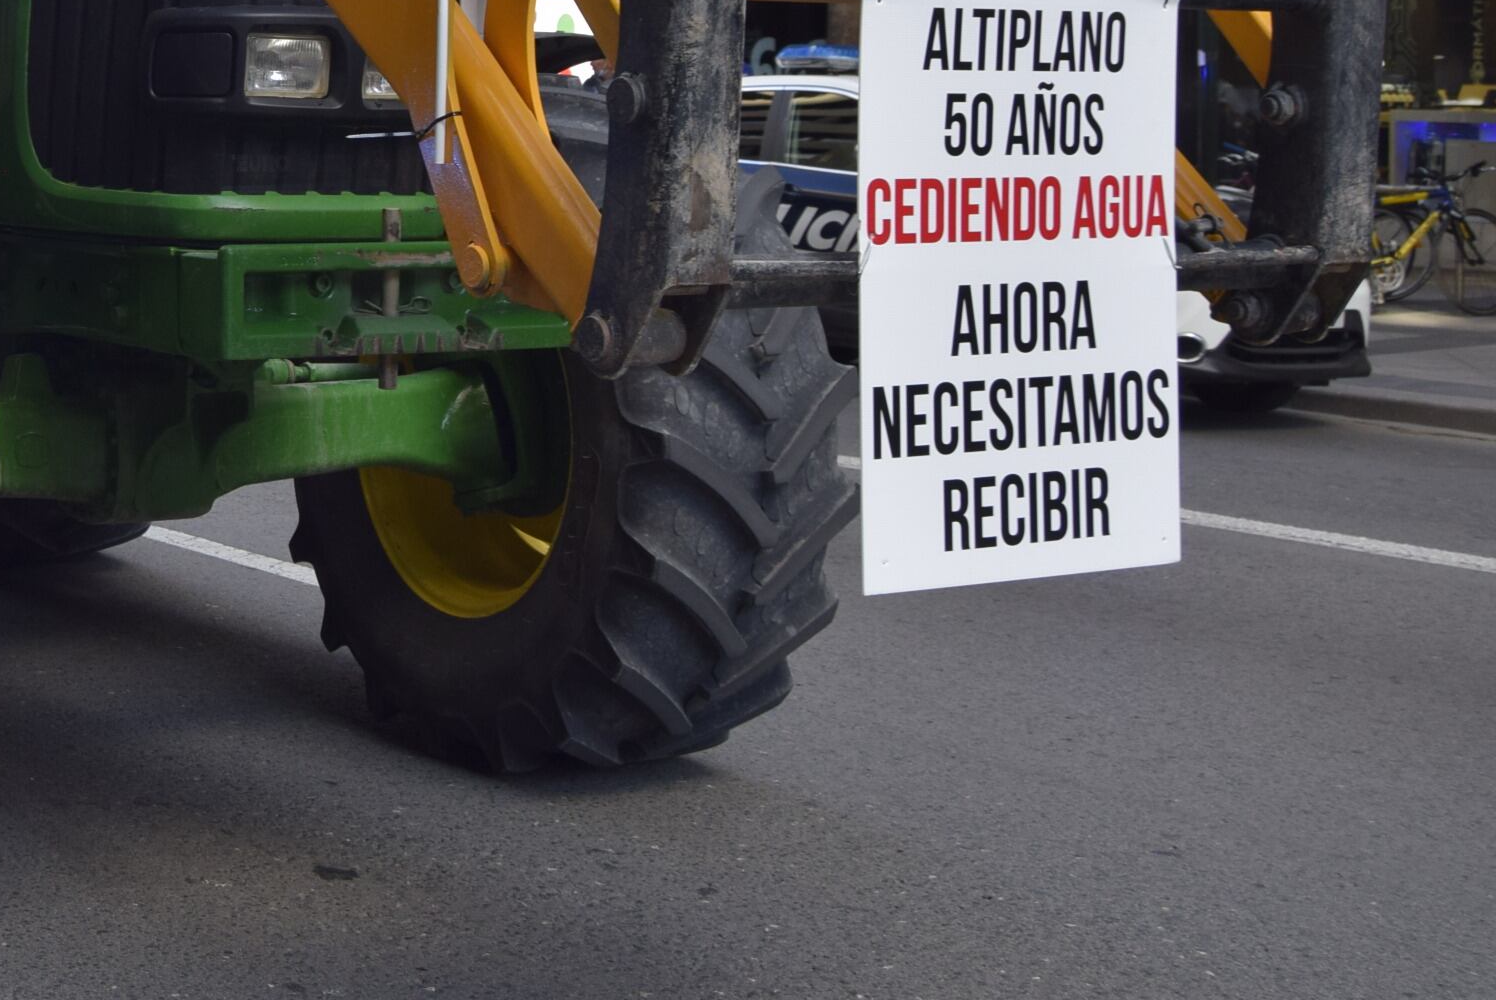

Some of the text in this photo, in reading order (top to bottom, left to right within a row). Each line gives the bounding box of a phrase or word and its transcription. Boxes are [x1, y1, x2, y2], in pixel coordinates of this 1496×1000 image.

[922, 7, 1126, 73] ALTIPLANO
[944, 81, 1104, 156] 50 AÑOS
[866, 174, 1169, 245] CEDIENDO AGUA
[951, 280, 1097, 356] AHORA
[872, 368, 1170, 459] NECESITAMOS
[943, 467, 1111, 551] RECIBIR
